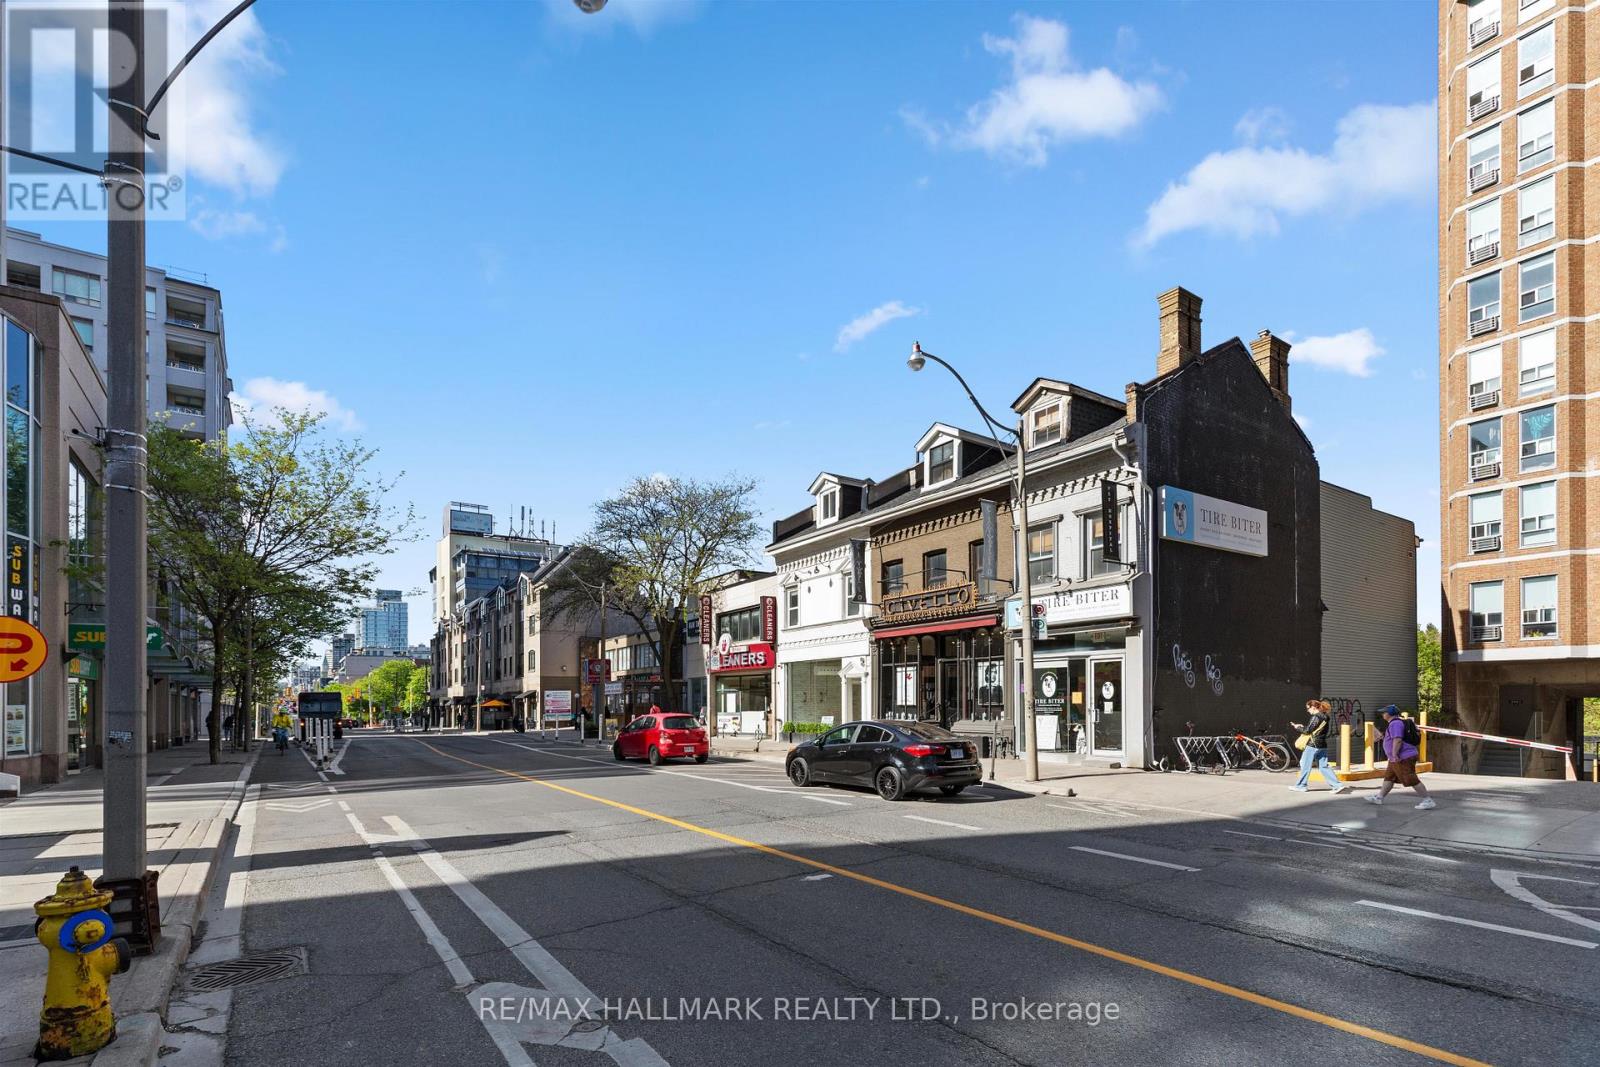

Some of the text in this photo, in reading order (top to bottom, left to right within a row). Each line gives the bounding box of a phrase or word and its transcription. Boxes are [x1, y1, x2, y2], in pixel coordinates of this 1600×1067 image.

[1200, 508, 1262, 535] TIRE BITER
[11, 545, 23, 616] SUBWA
[887, 588, 970, 615] CIVELLO
[1075, 589, 1119, 605] BITER
[702, 605, 710, 642] CLEANERS
